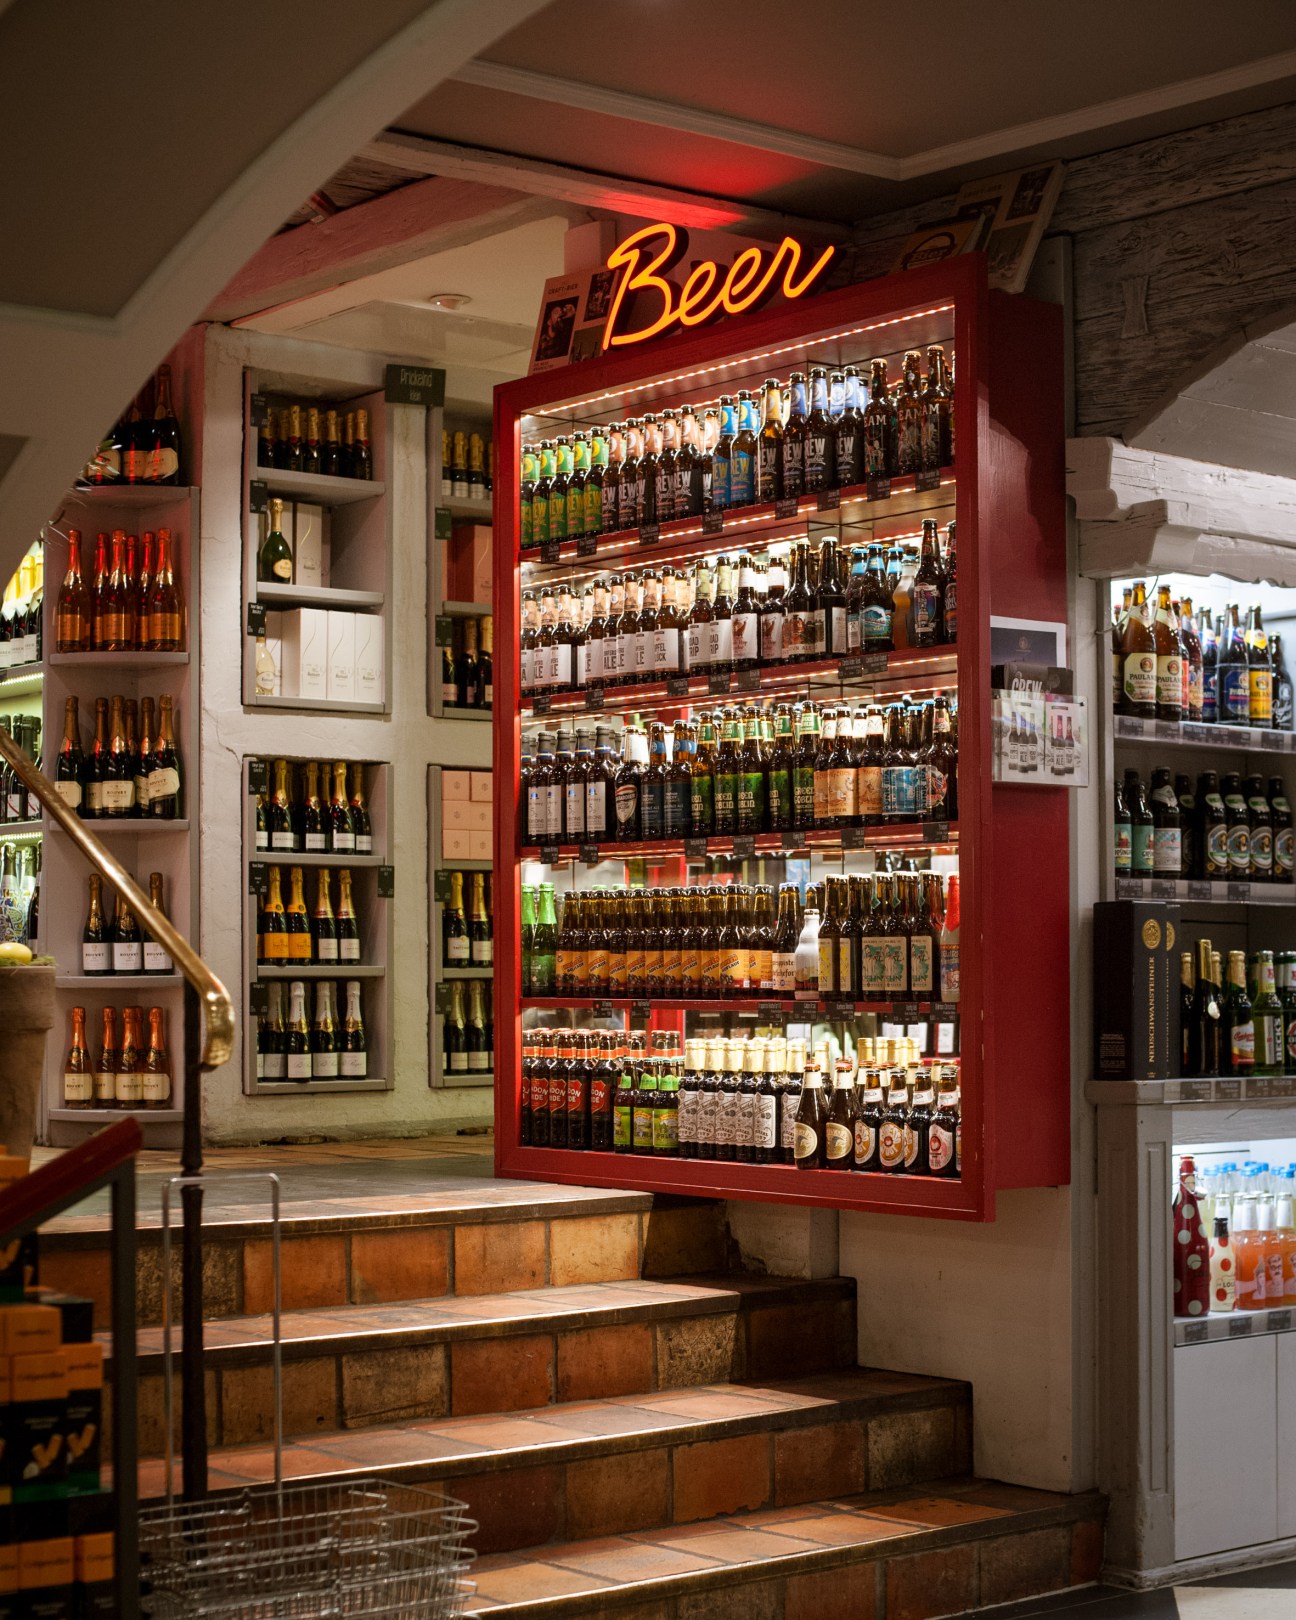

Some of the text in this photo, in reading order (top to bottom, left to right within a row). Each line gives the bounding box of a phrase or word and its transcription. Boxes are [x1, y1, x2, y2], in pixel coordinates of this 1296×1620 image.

[603, 222, 836, 350] Beer
[804, 438, 825, 456] REW
[636, 651, 644, 665] LE
[534, 666, 543, 678] LE
